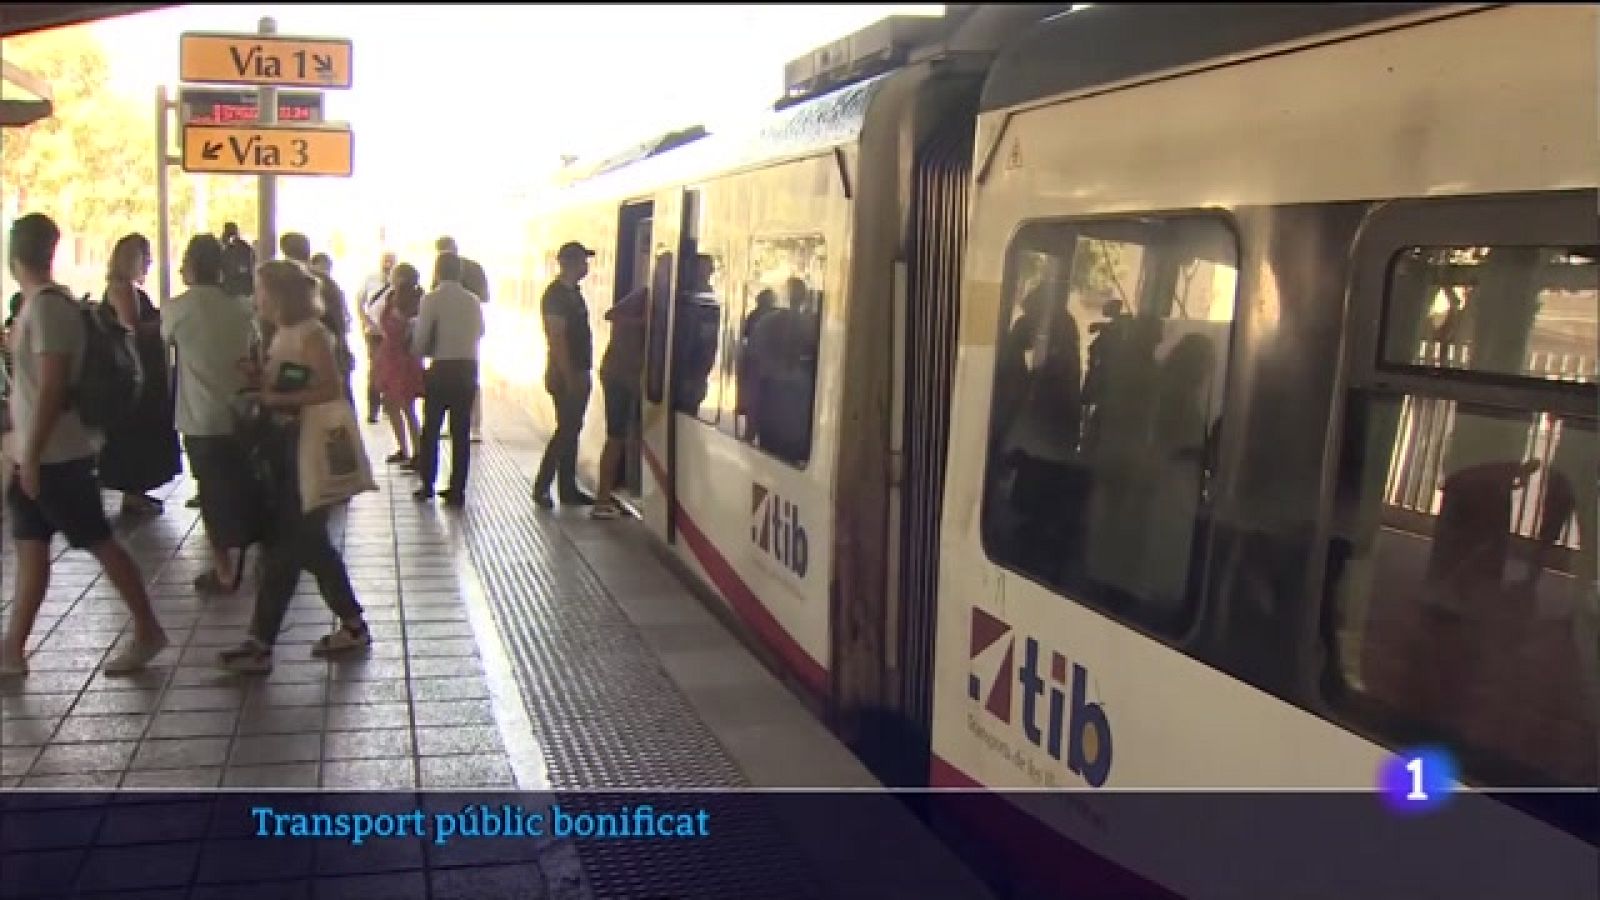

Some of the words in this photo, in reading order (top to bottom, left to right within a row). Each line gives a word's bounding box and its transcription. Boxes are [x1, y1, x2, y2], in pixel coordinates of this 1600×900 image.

[229, 45, 281, 78] Via
[293, 49, 307, 79] 1
[228, 134, 281, 166] Via
[290, 139, 309, 167] 3
[772, 494, 809, 579] tib
[1019, 636, 1113, 788] tib
